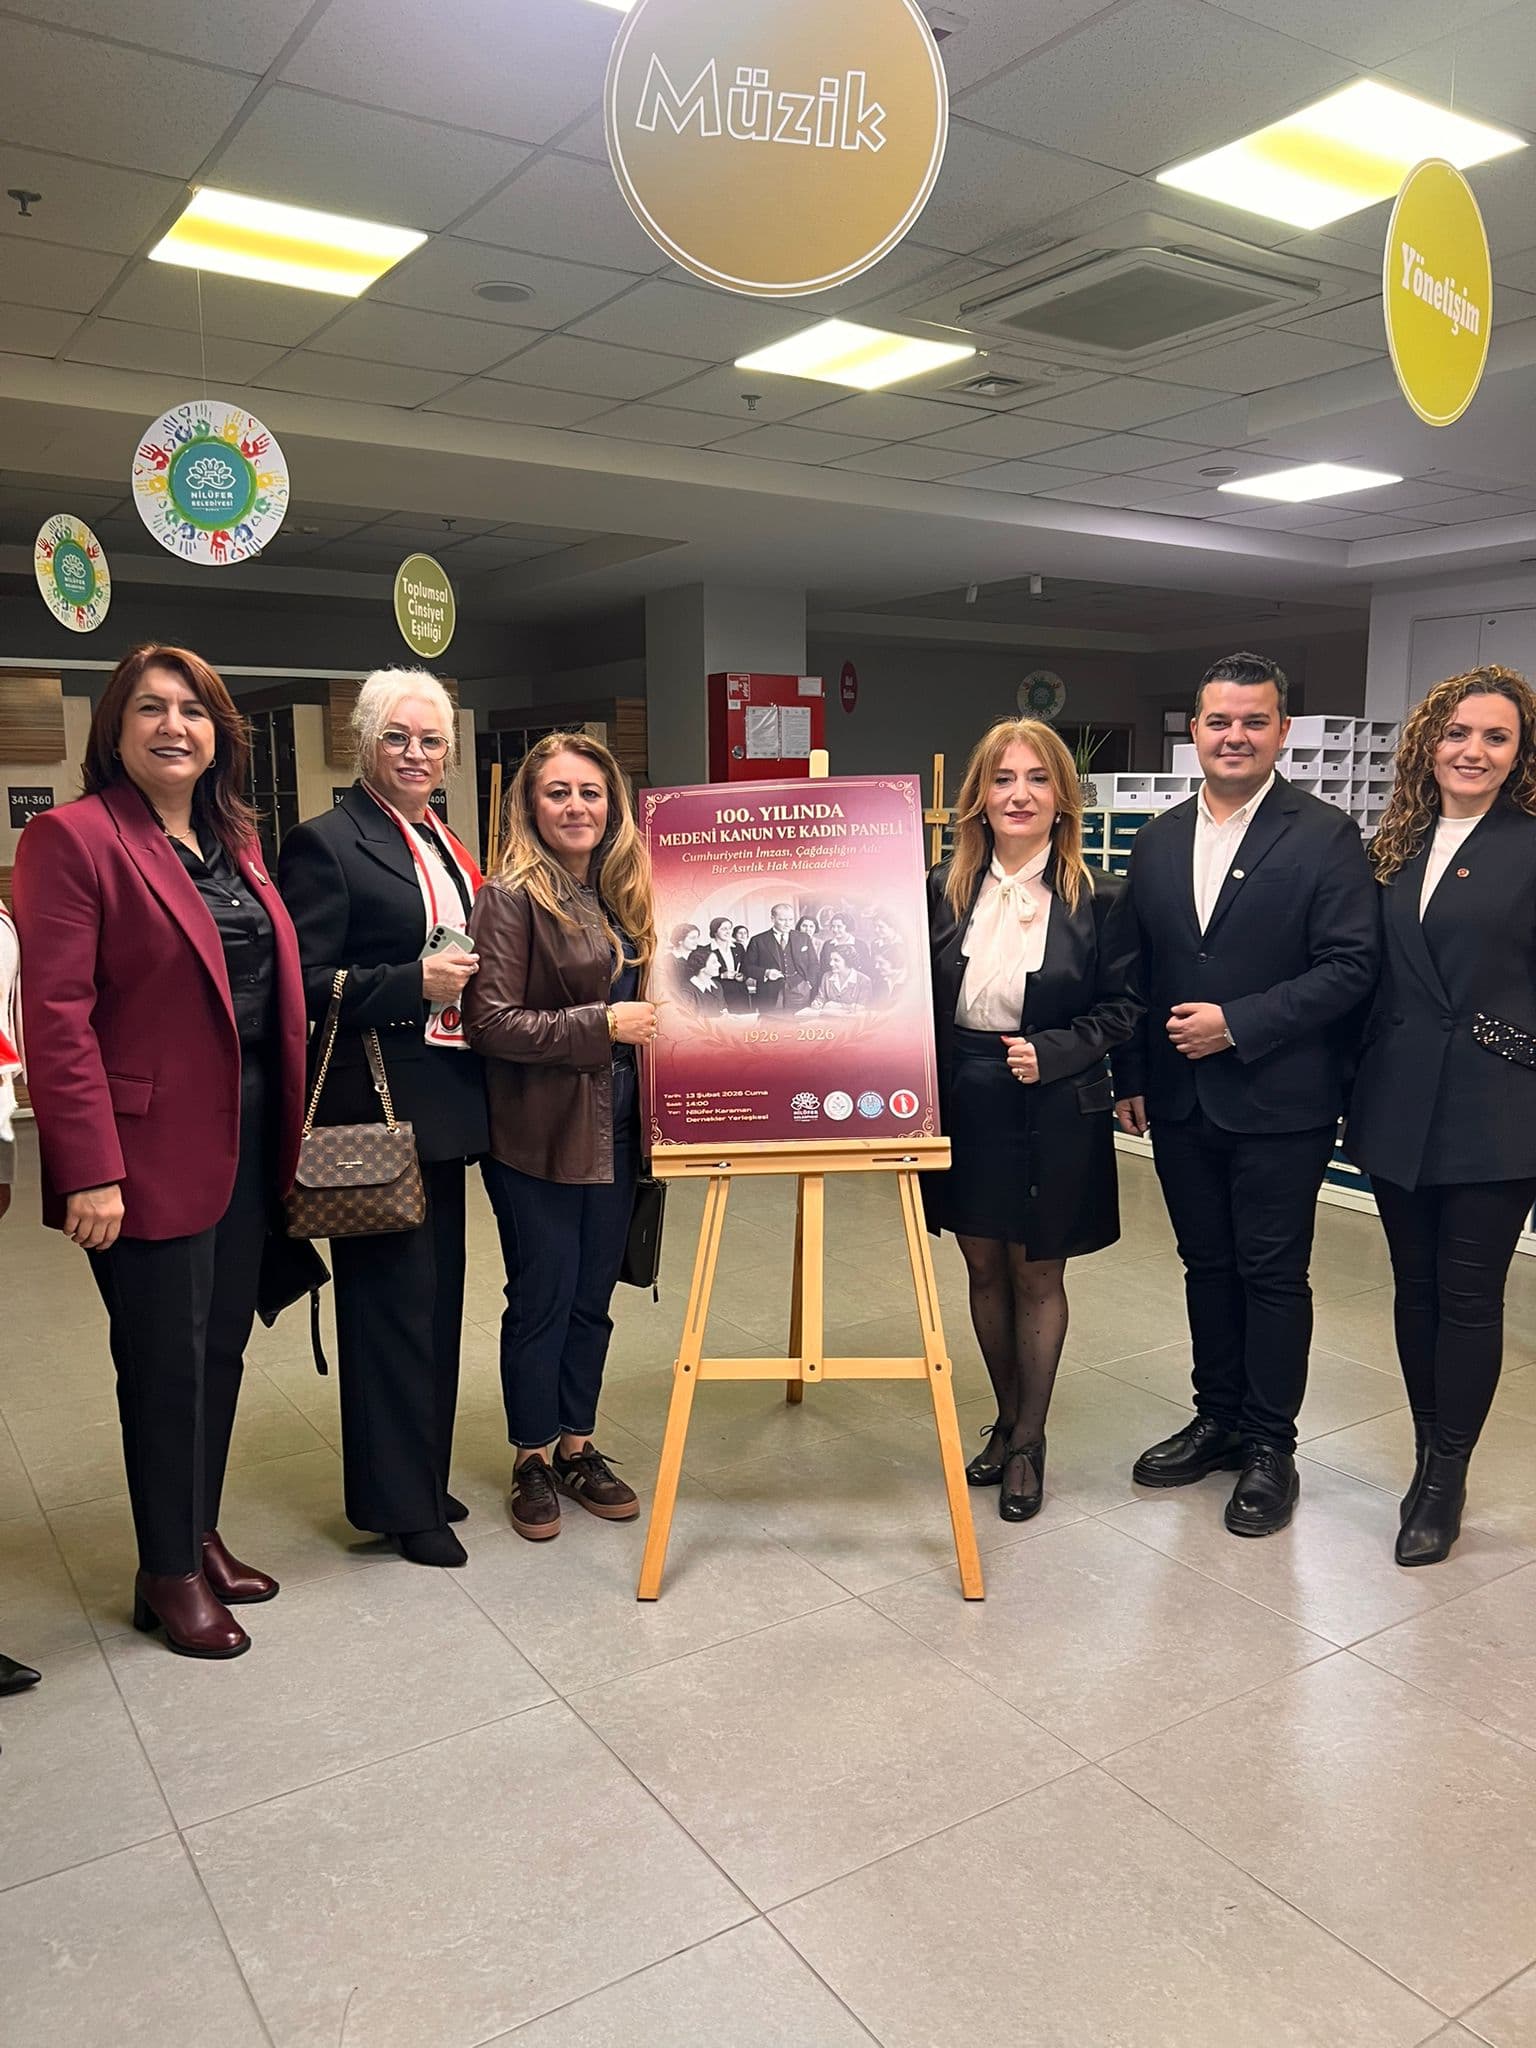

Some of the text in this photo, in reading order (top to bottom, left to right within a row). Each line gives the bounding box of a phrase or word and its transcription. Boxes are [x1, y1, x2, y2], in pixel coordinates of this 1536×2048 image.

[635, 52, 887, 152] Müzik
[191, 490, 233, 499] NİLÜFER
[402, 577, 448, 604] Toplumsal
[408, 598, 444, 622] Cinsiyet
[411, 618, 442, 643] Eşitliği
[11, 795, 51, 805] 341-360
[715, 803, 845, 824] 100. YILINDA
[659, 820, 903, 847] MEDENİ KANUN VE KADIN PANELİ
[681, 849, 753, 863] Cumhuriyetin
[795, 844, 857, 860] Çağdaşlığın
[711, 858, 850, 875] Bir Asırlık Hak Mücadelesi
[743, 1029, 779, 1043] 1926
[797, 1028, 835, 1041] 2026
[696, 1091, 720, 1099] Şubat
[744, 1089, 769, 1097] Cuma
